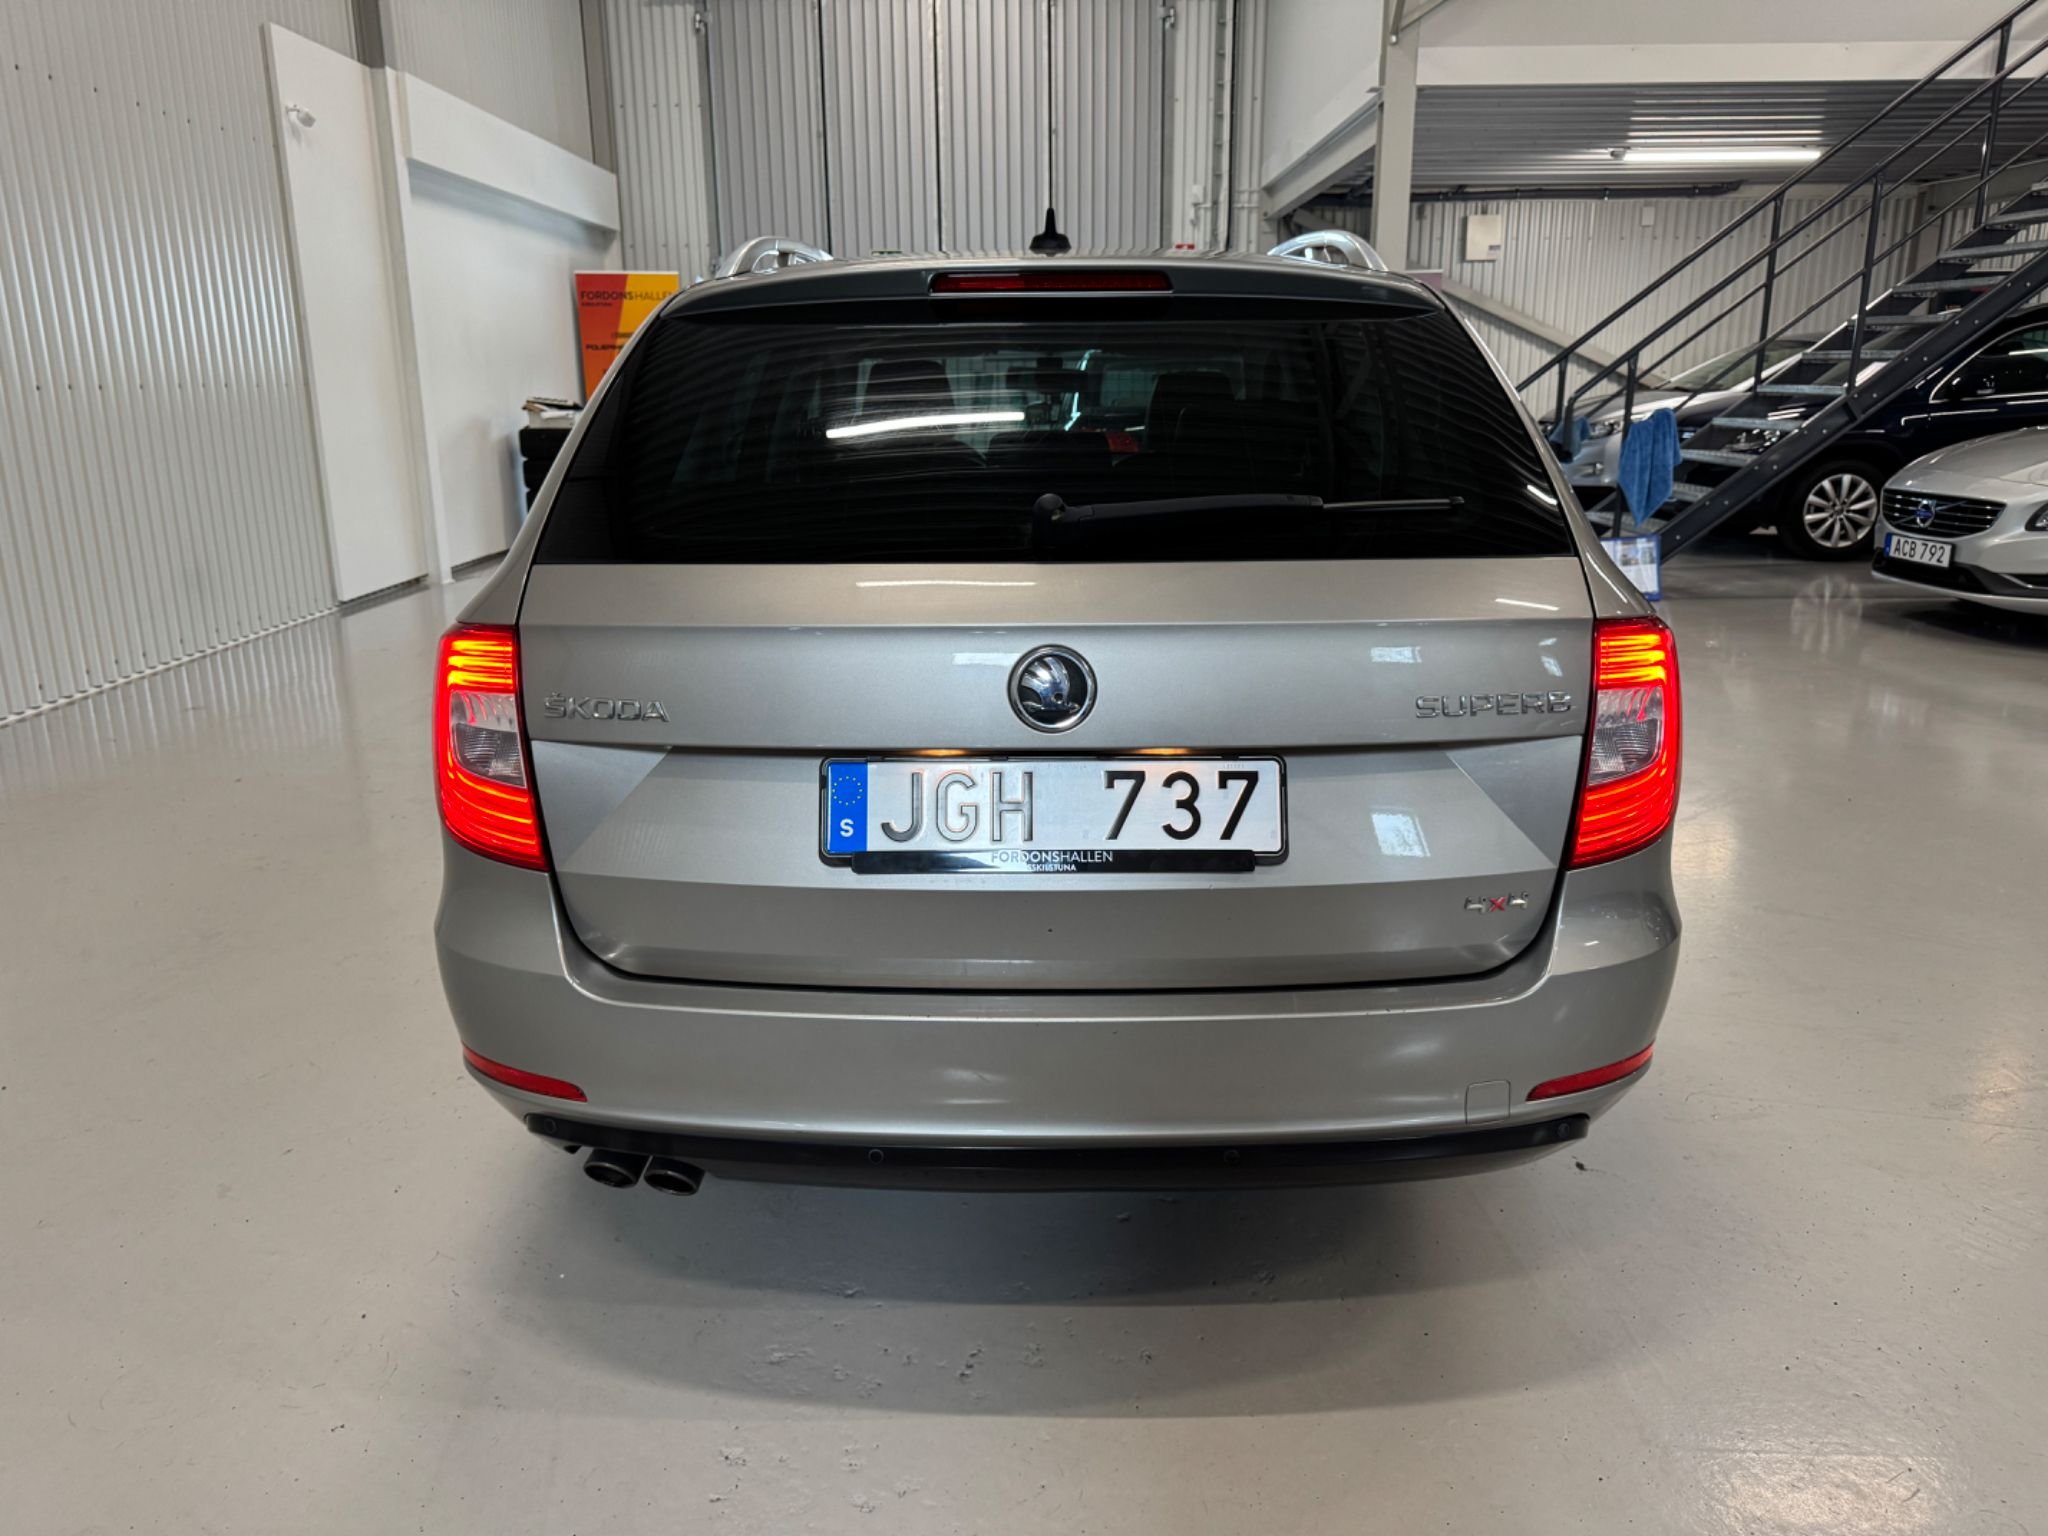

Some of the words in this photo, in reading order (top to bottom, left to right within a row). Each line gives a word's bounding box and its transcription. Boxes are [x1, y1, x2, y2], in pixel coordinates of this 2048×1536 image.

[1894, 538, 1917, 558] ACB
[1920, 542, 1946, 564] 792
[544, 692, 670, 722] ŠKODA
[1415, 691, 1571, 719] SUPERB
[881, 771, 1034, 842] JGH
[1104, 770, 1259, 841] 737
[840, 819, 854, 837] S
[991, 850, 1113, 863] FORDONSHALLEN
